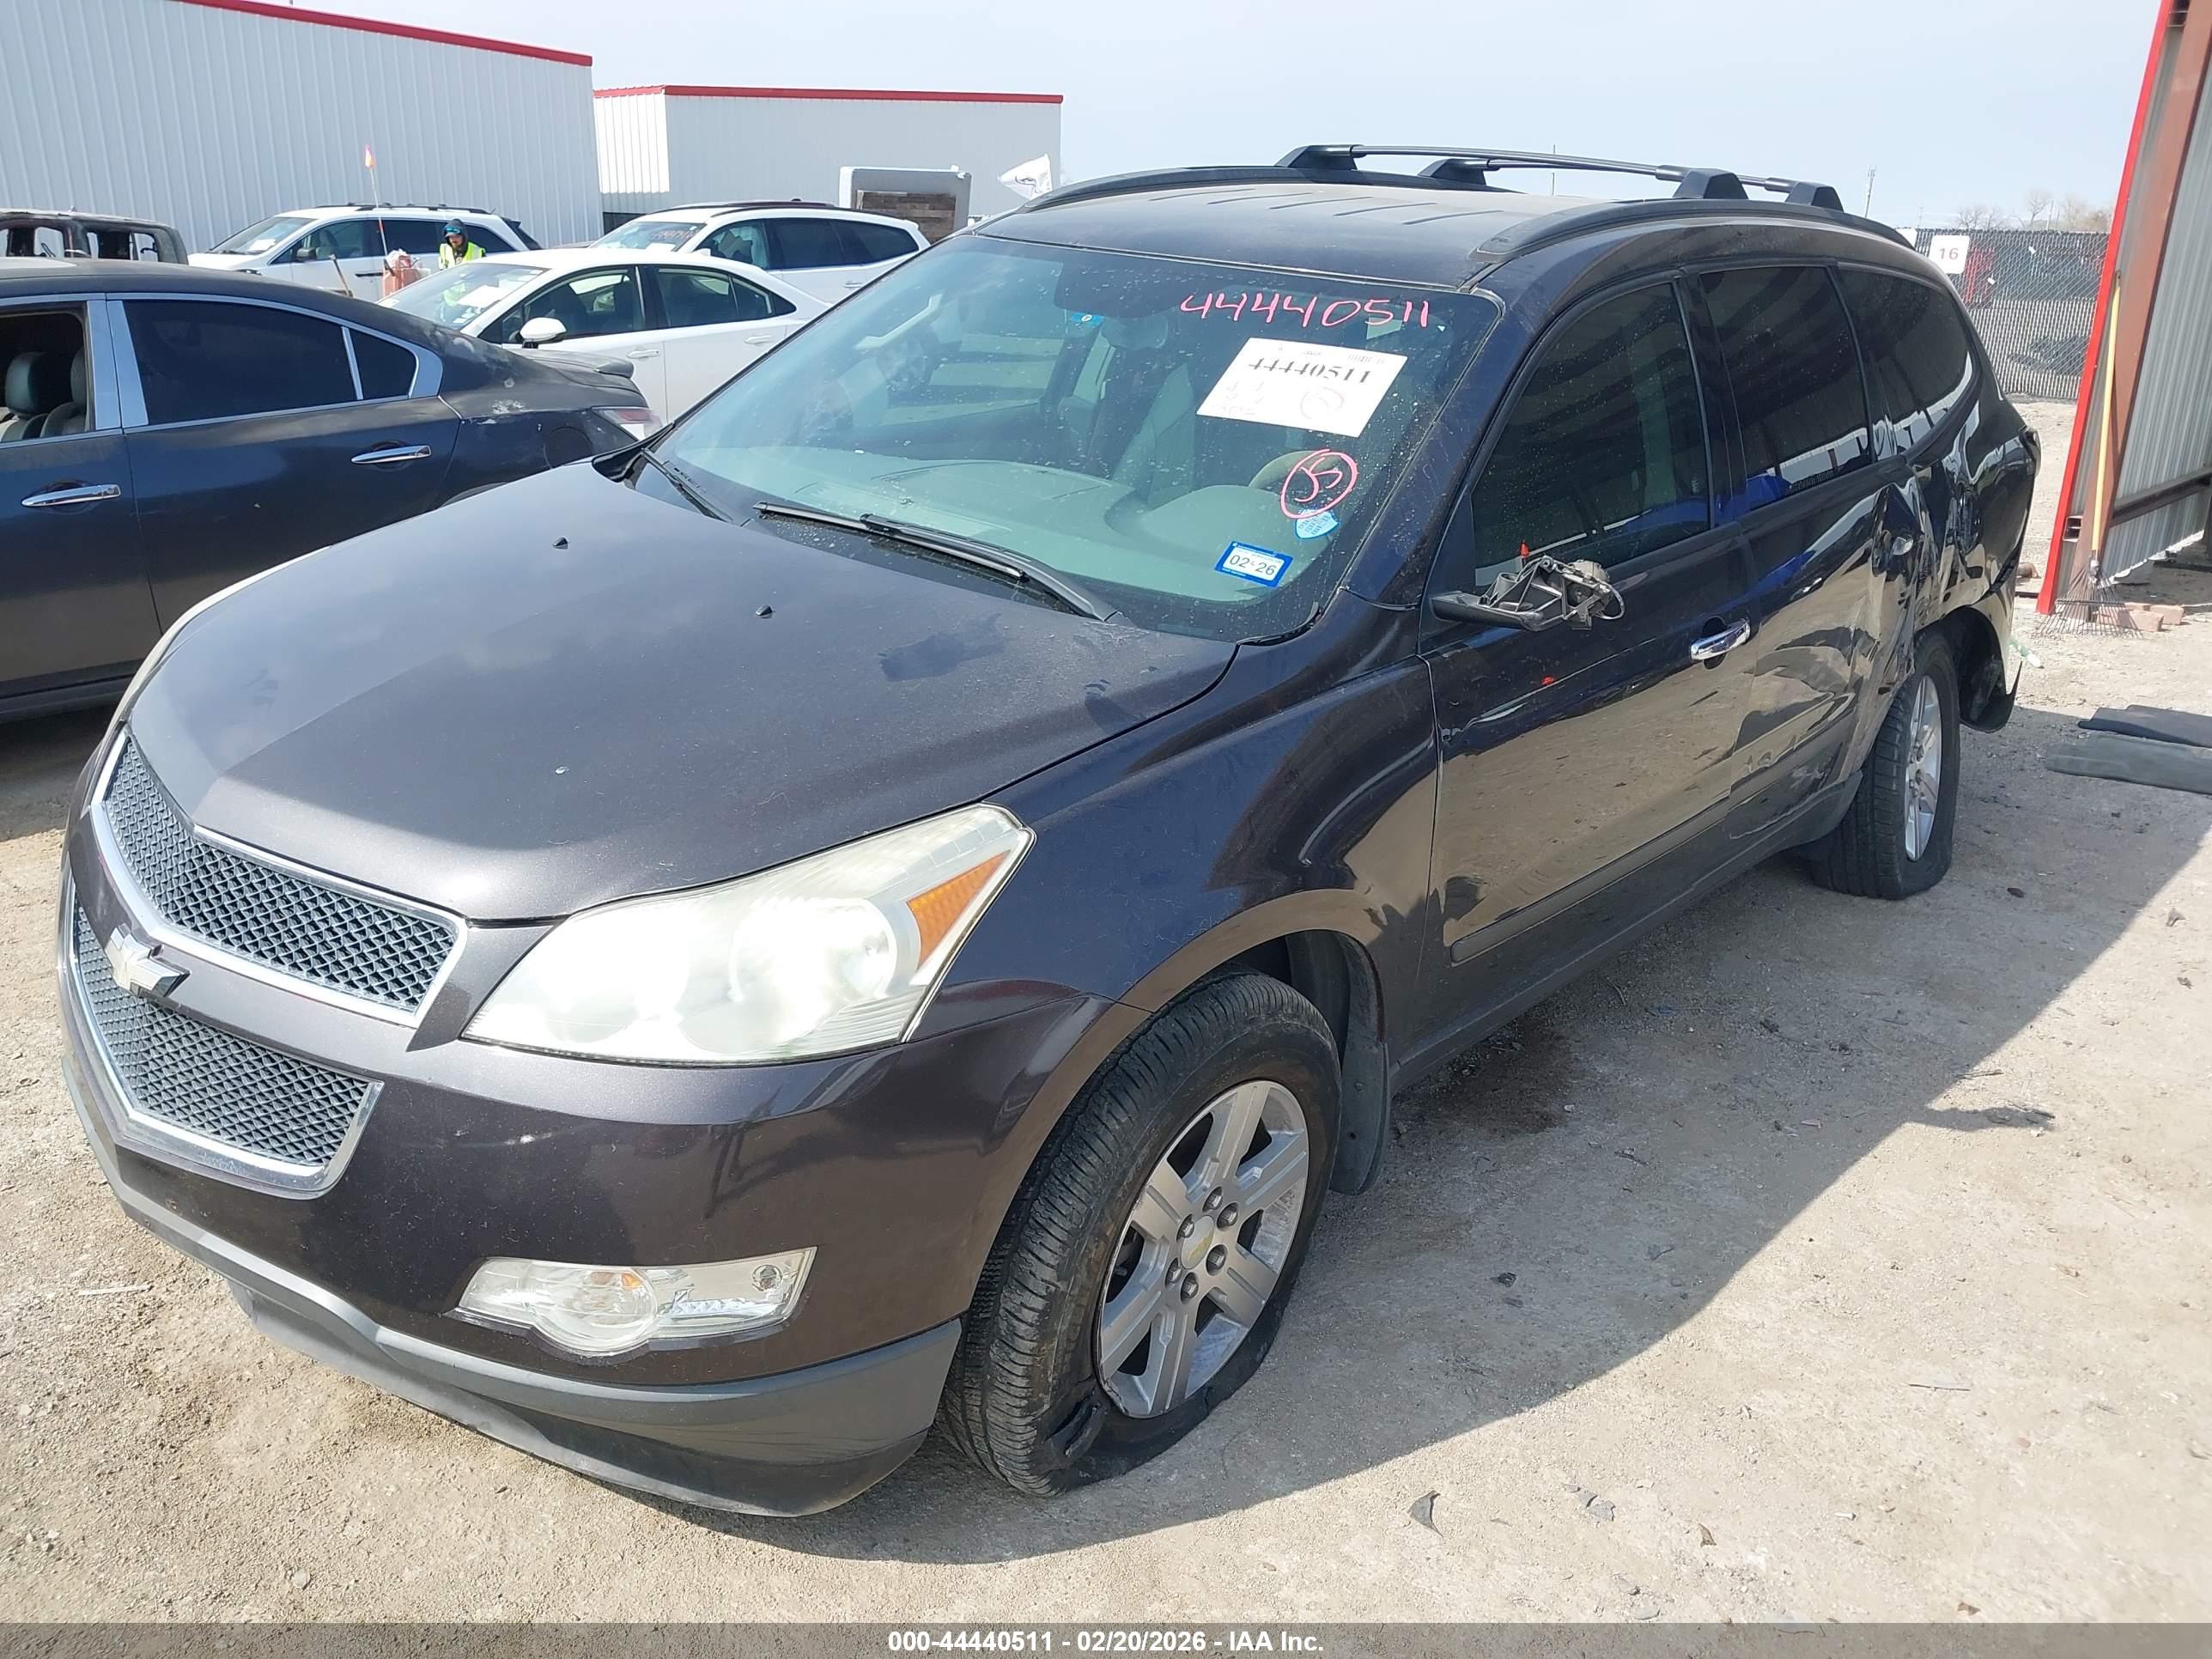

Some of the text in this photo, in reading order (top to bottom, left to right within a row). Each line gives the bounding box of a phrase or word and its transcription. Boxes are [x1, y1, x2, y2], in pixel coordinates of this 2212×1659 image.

[1939, 247, 1959, 260] 16
[1180, 293, 1429, 327] 44440511
[1249, 357, 1371, 384] 44440511
